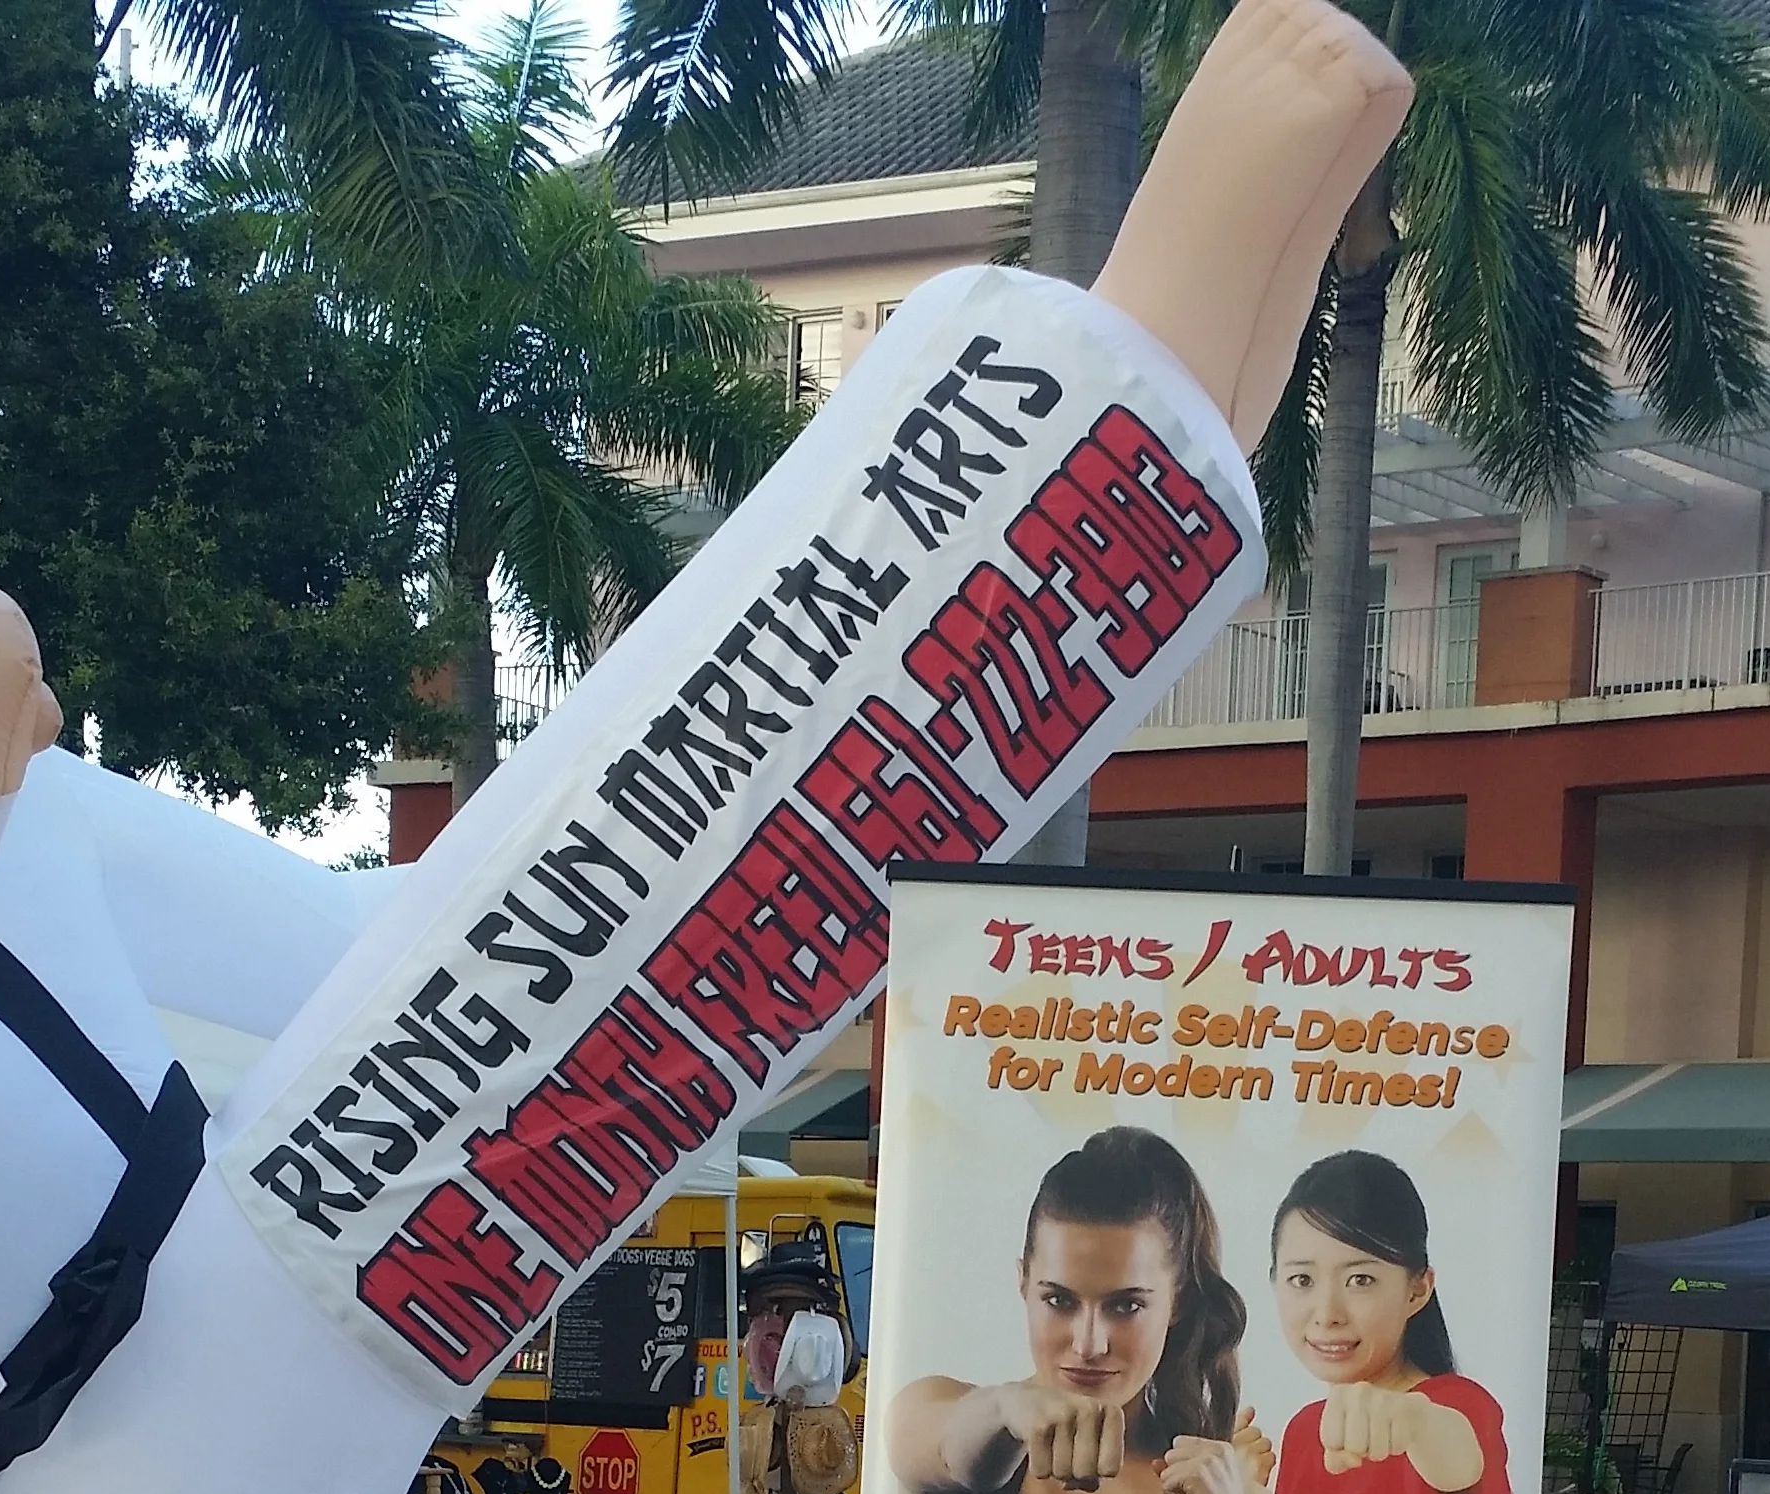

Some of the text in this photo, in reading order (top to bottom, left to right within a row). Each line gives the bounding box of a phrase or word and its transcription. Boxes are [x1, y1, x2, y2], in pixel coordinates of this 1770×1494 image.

[249, 335, 1064, 1240] RISING SUN MARTIAL ARTS
[1182, 920, 1233, 987] /
[943, 995, 1510, 1059] Realistic Self-Defense
[987, 1047, 1463, 1109] for Modern Times!
[356, 1179, 565, 1386] ONE
[461, 984, 738, 1272] MONTH
[644, 1249, 673, 1266] VEGGIE
[674, 1249, 696, 1268] DOGS
[657, 1324, 689, 1338] COMBO
[582, 1456, 636, 1491] STOP
